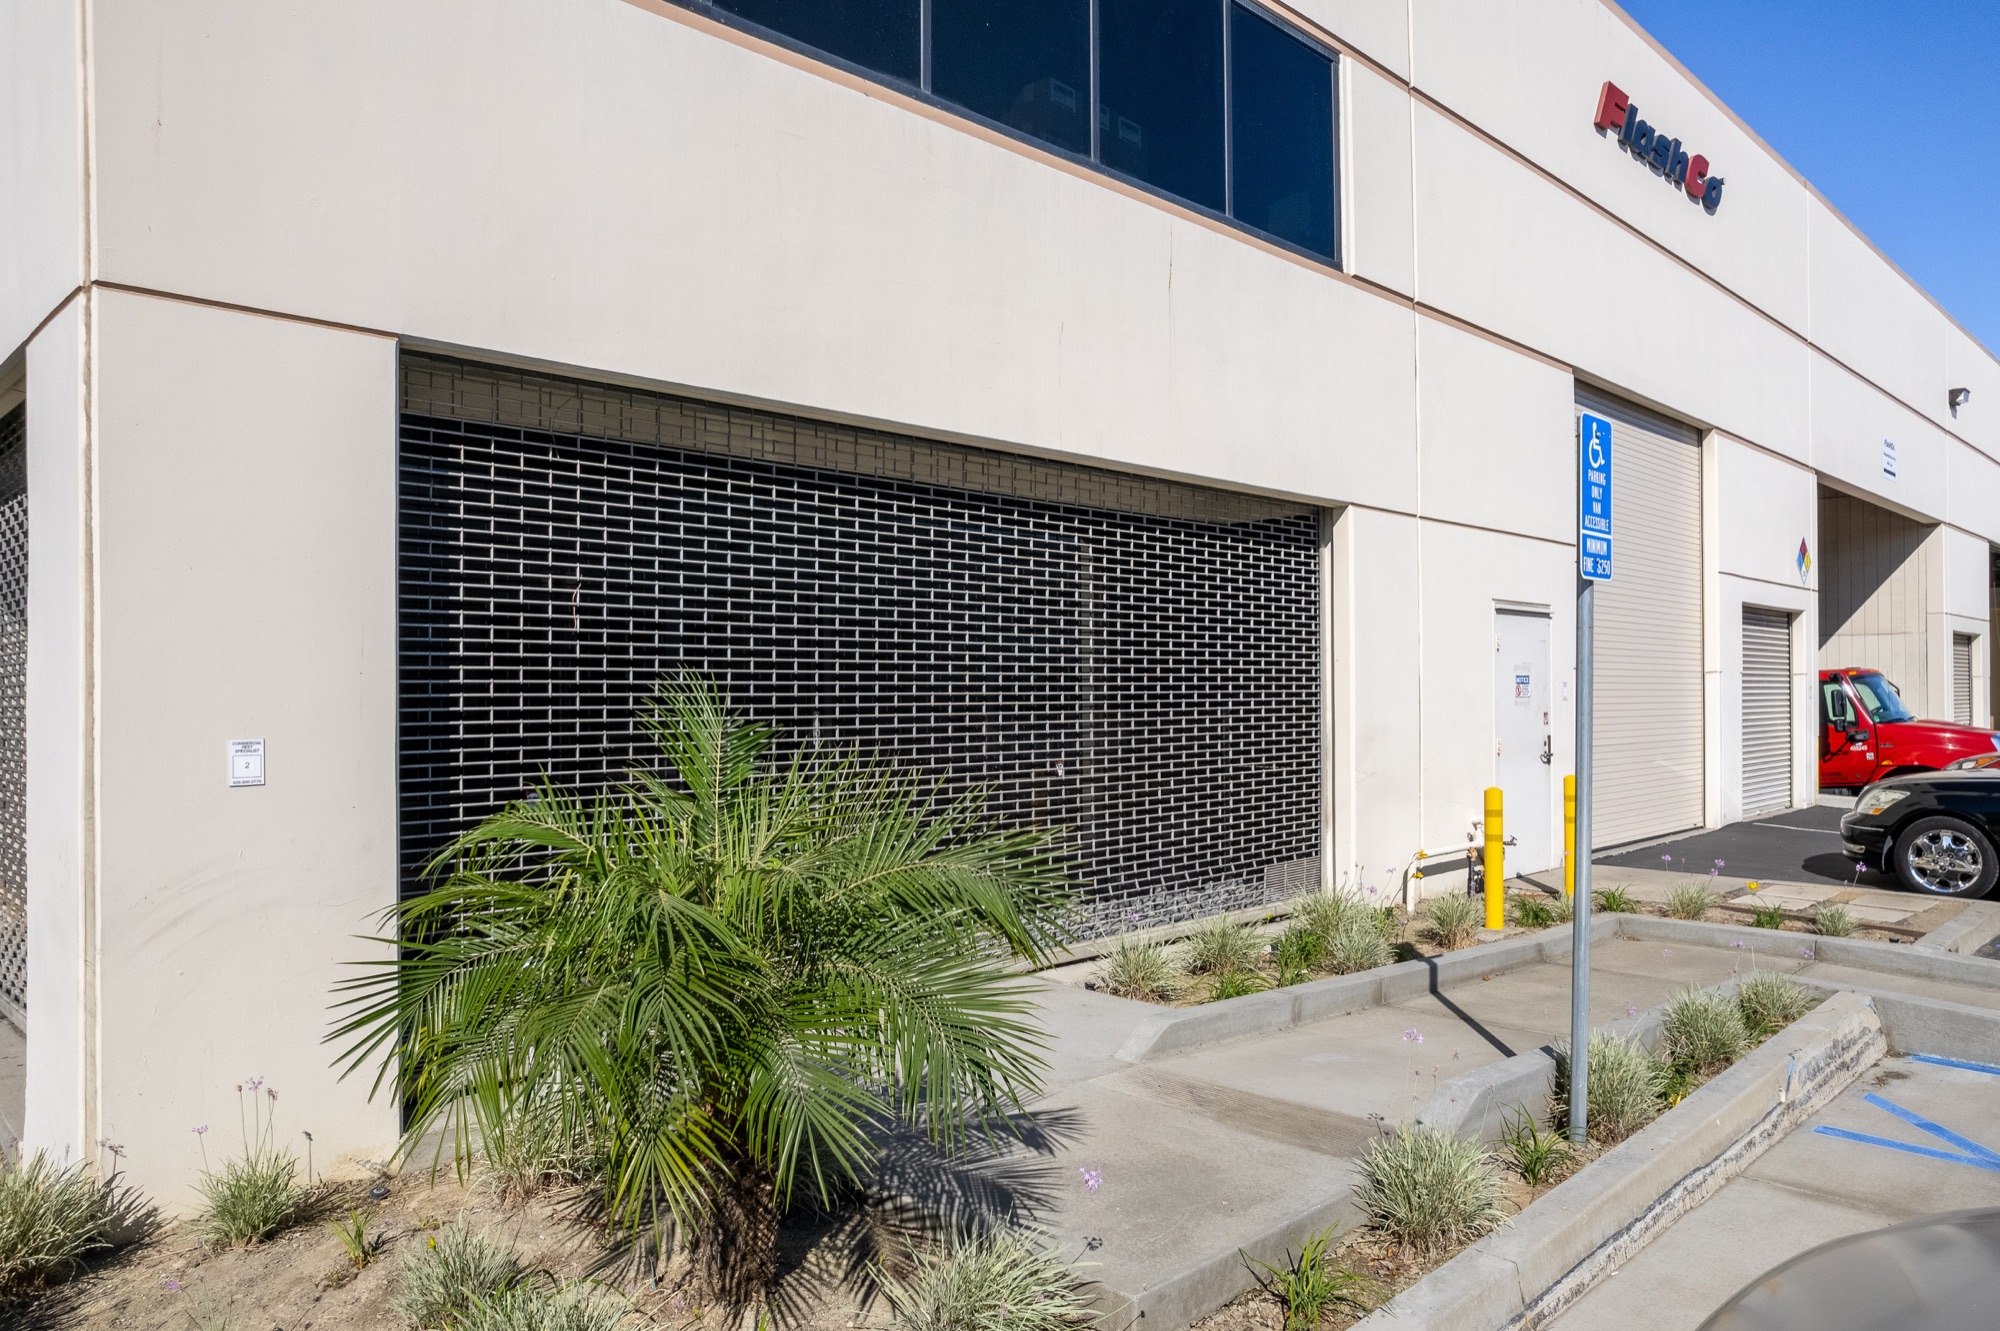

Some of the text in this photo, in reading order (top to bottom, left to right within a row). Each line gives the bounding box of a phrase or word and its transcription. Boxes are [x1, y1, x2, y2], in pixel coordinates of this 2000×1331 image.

[1594, 80, 1724, 210] FlashCo
[1588, 469, 1606, 486] PARKING
[1591, 485, 1602, 500] ONLY
[1593, 501, 1601, 515] VAN
[1585, 514, 1609, 532] ACCESSIBLE
[1587, 537, 1607, 556] MINIMUM
[1584, 556, 1594, 573] FINE
[244, 761, 250, 769] 2
